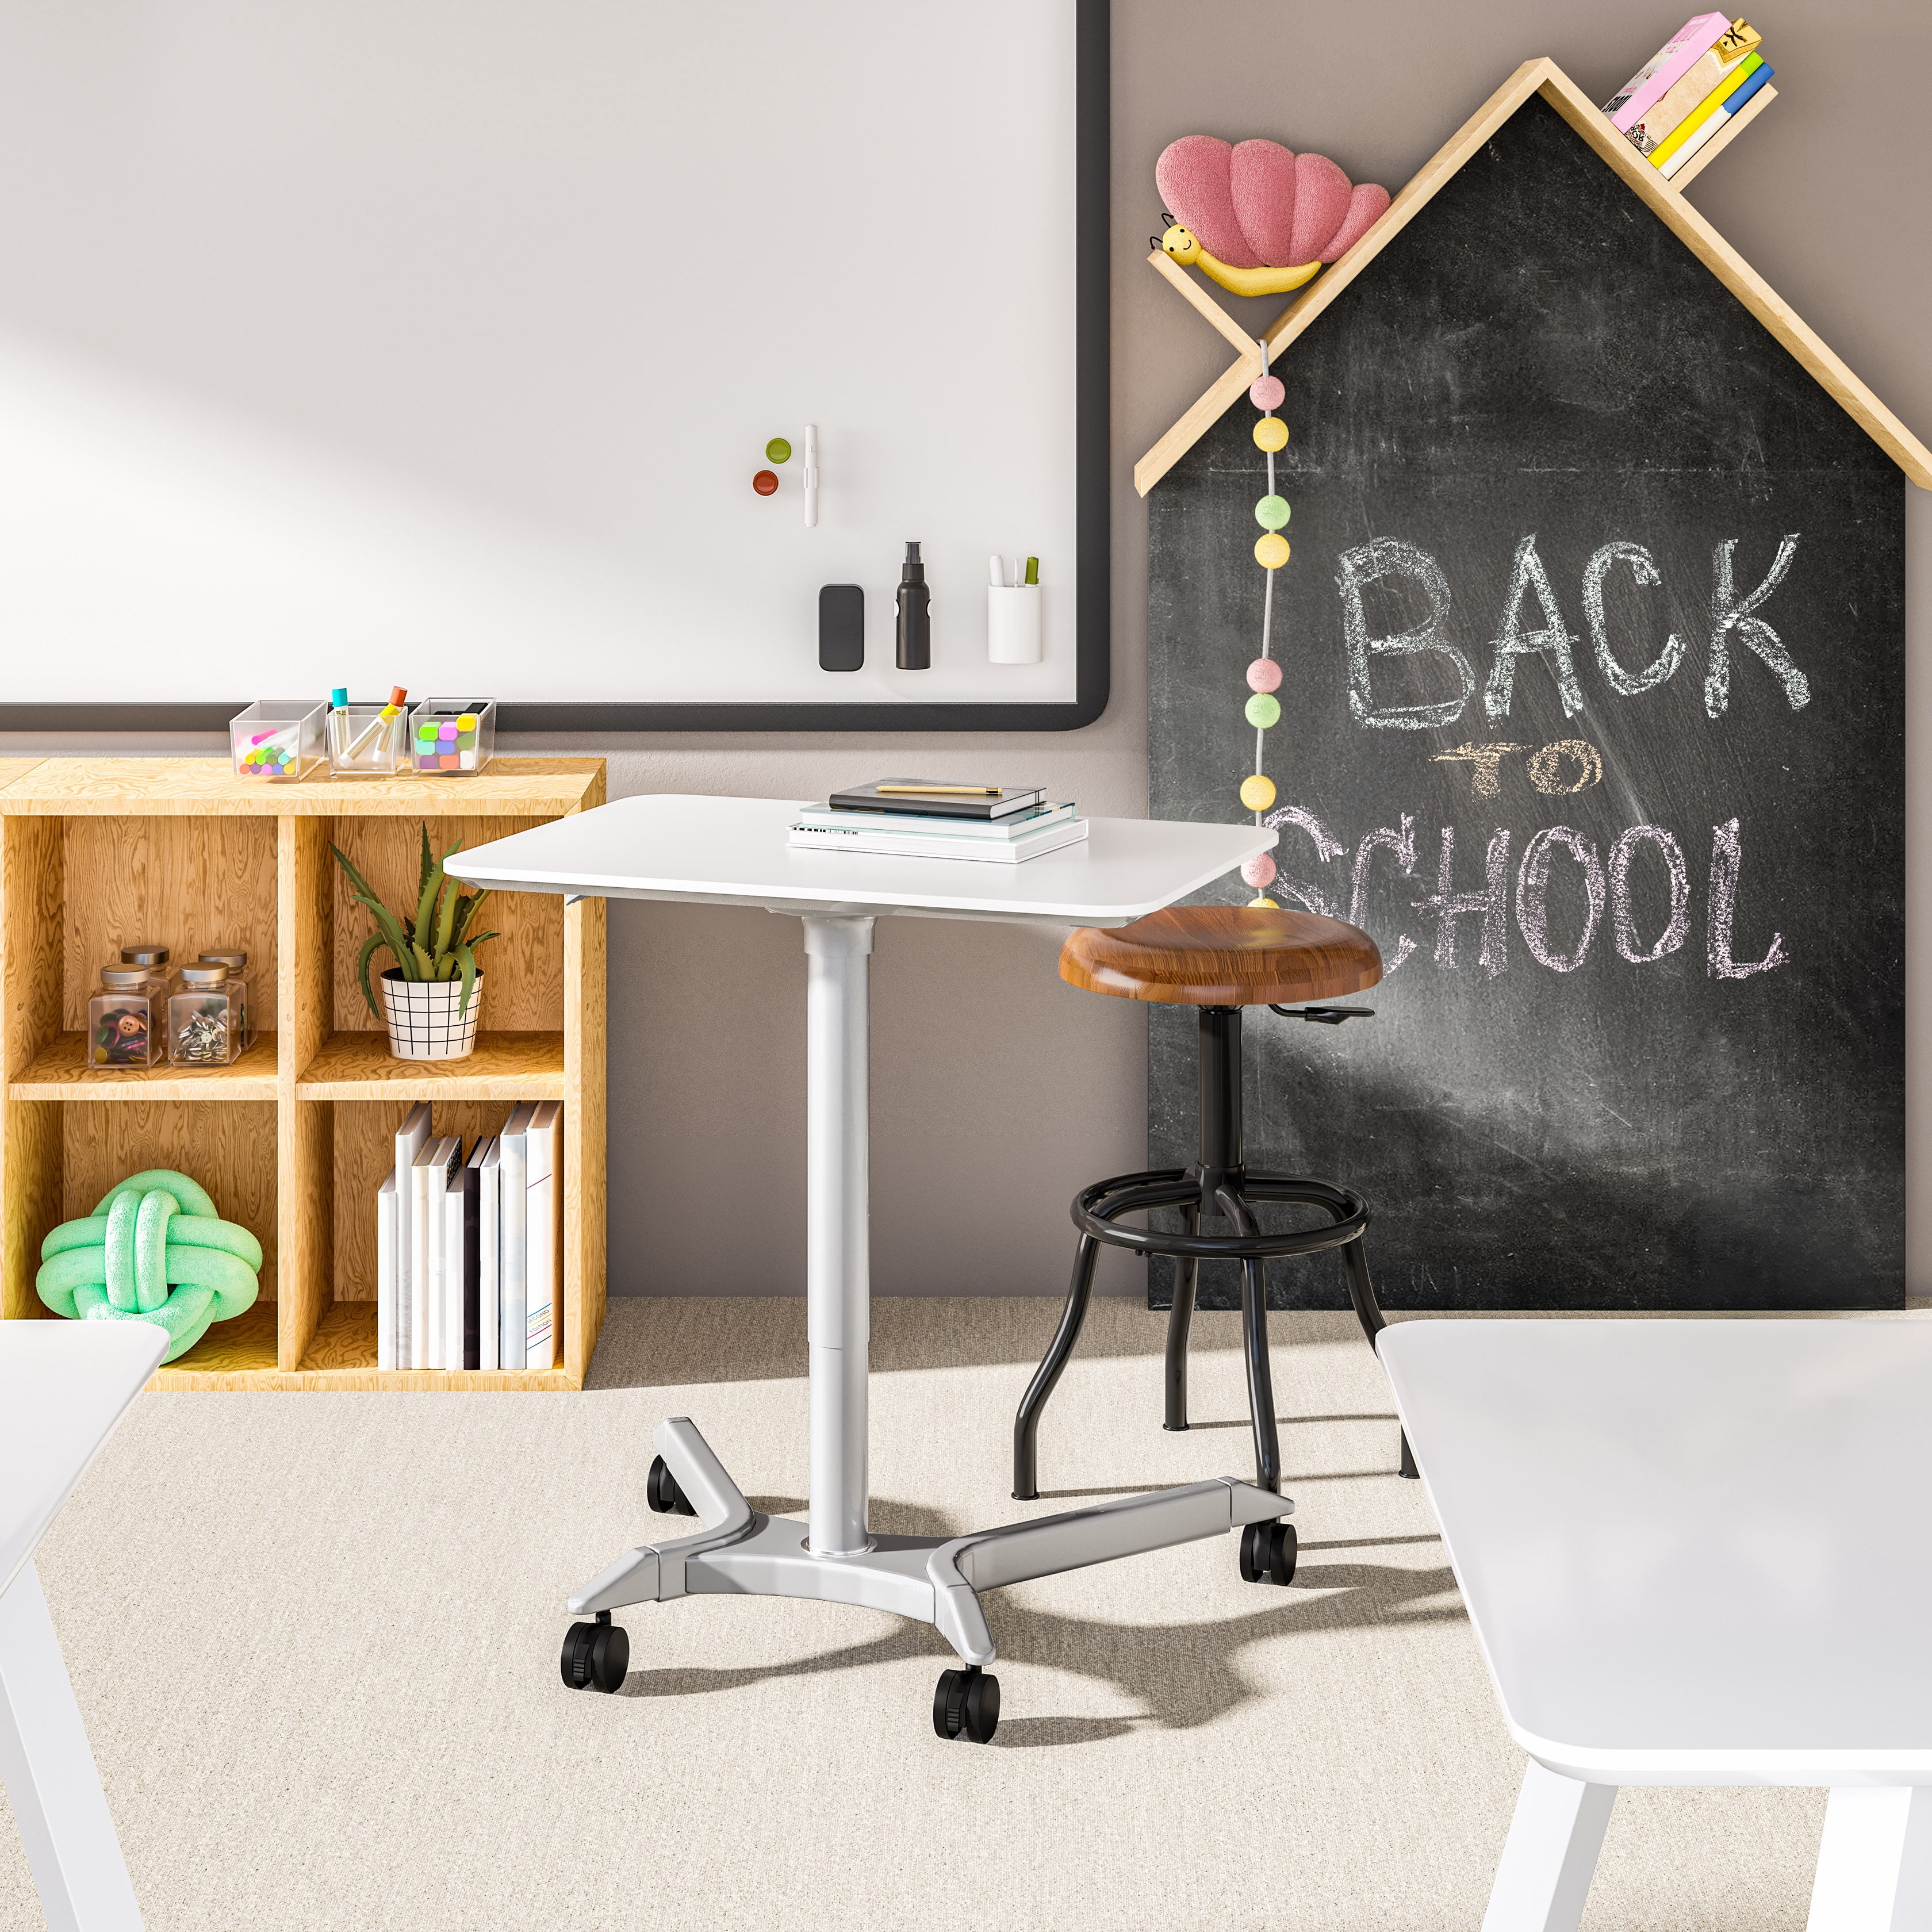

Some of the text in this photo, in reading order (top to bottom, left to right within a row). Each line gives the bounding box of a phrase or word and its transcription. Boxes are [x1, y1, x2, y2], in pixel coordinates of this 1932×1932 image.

[1334, 531, 1812, 730] BACK
[1428, 739, 1603, 802] TO
[1264, 804, 1789, 980] SCHOOL
[529, 1318, 552, 1333] EDITION
